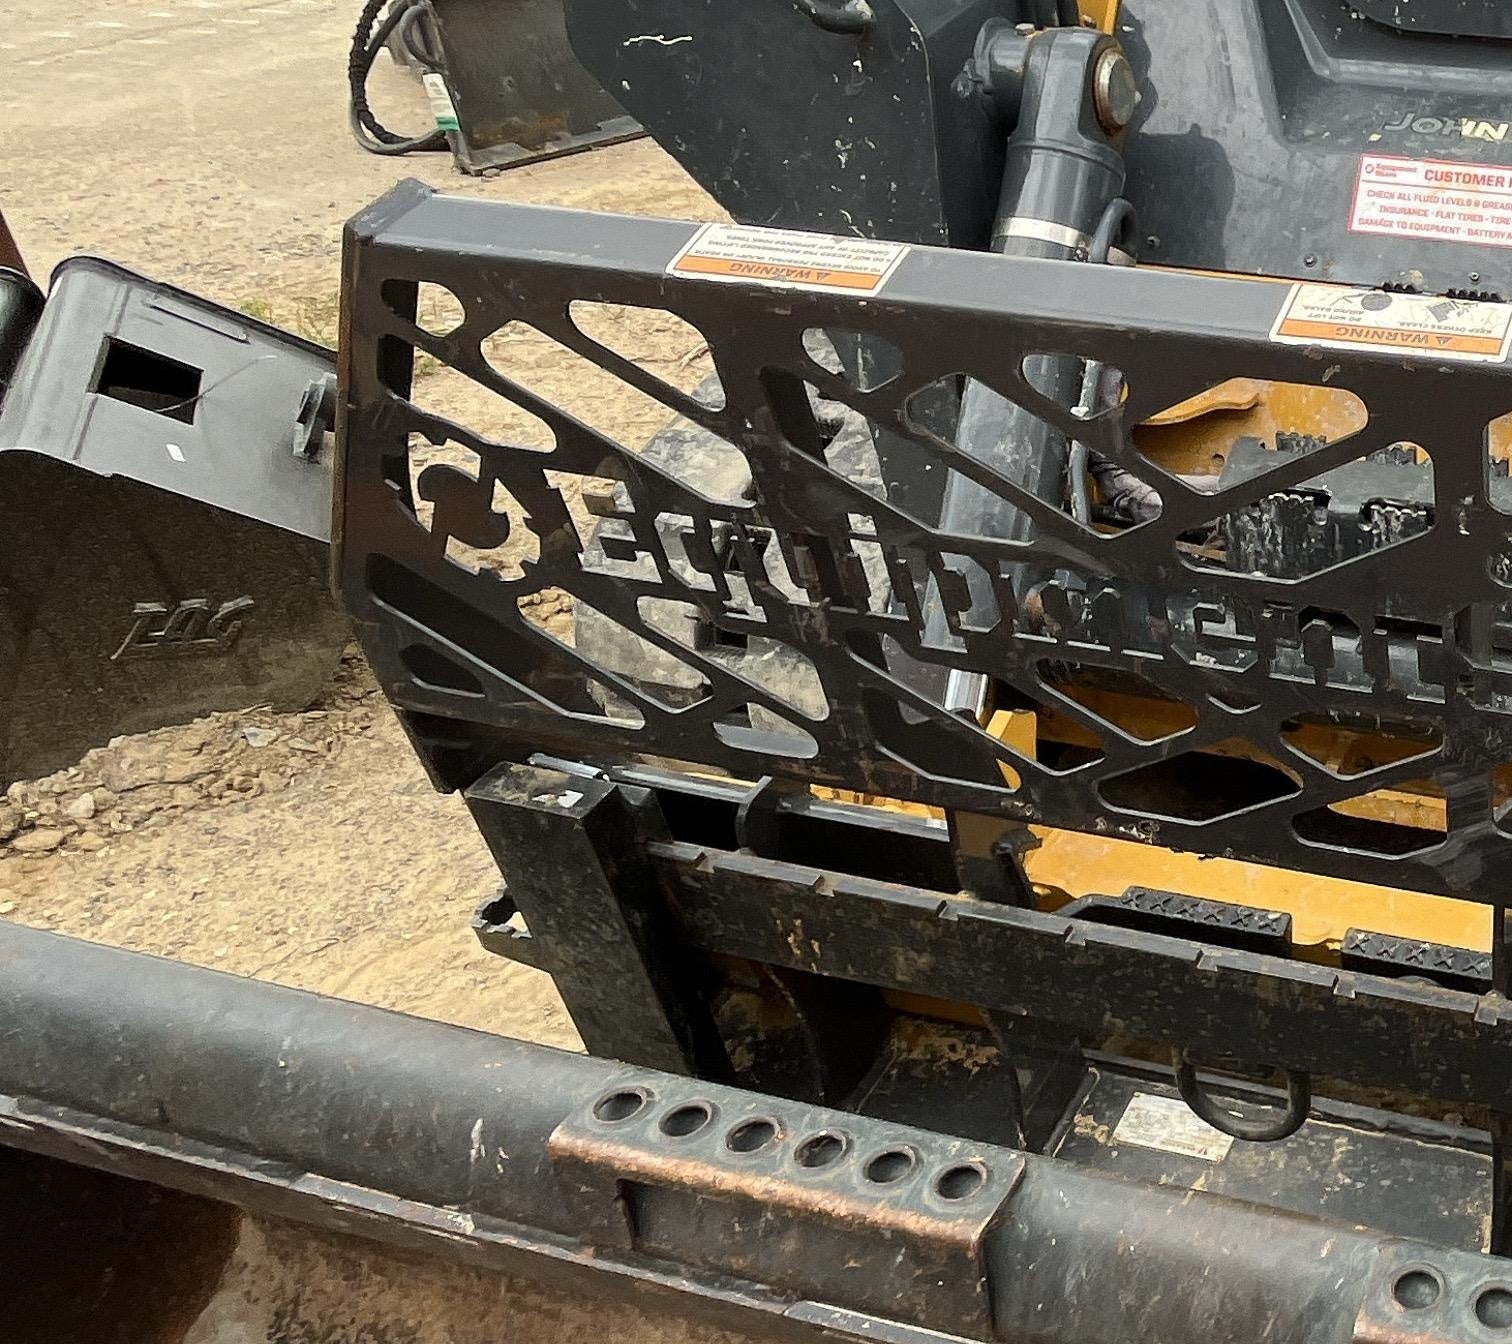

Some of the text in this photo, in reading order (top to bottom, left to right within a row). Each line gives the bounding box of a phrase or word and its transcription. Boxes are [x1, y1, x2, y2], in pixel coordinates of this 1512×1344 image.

[1384, 112, 1508, 142] JOHN
[1424, 169, 1505, 188] CUSTOMER
[1367, 189, 1395, 200] CHECK
[1397, 192, 1412, 201] ALL
[729, 263, 811, 279] WARNING
[1335, 326, 1429, 344] WARNING
